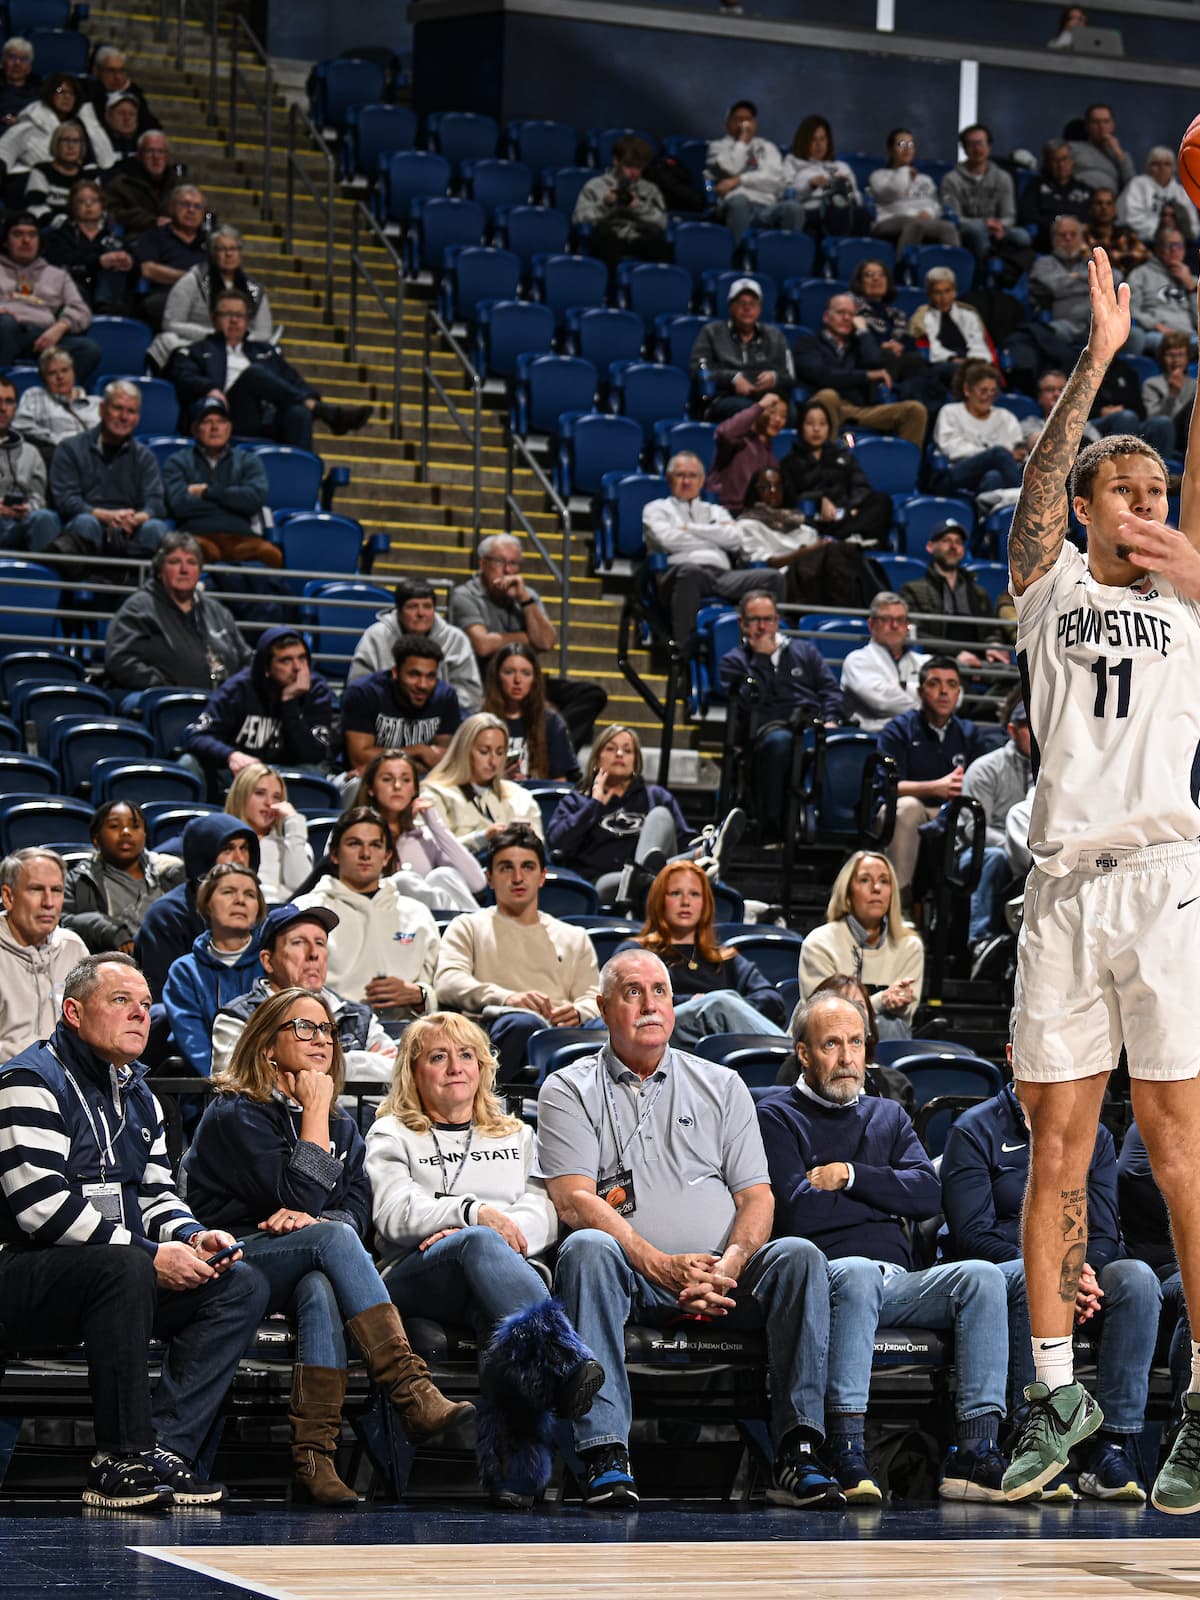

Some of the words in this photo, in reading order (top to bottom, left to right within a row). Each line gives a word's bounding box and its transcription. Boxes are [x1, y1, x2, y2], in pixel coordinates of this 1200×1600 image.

[1058, 606, 1102, 648] PENN
[1104, 610, 1171, 658] STATE
[1091, 656, 1133, 719] 11
[1096, 859, 1118, 868] PSU
[418, 1152, 464, 1166] PENN
[472, 1148, 520, 1162] STATE
[884, 1342, 906, 1353] JORDAN
[906, 1343, 929, 1352] CENTER
